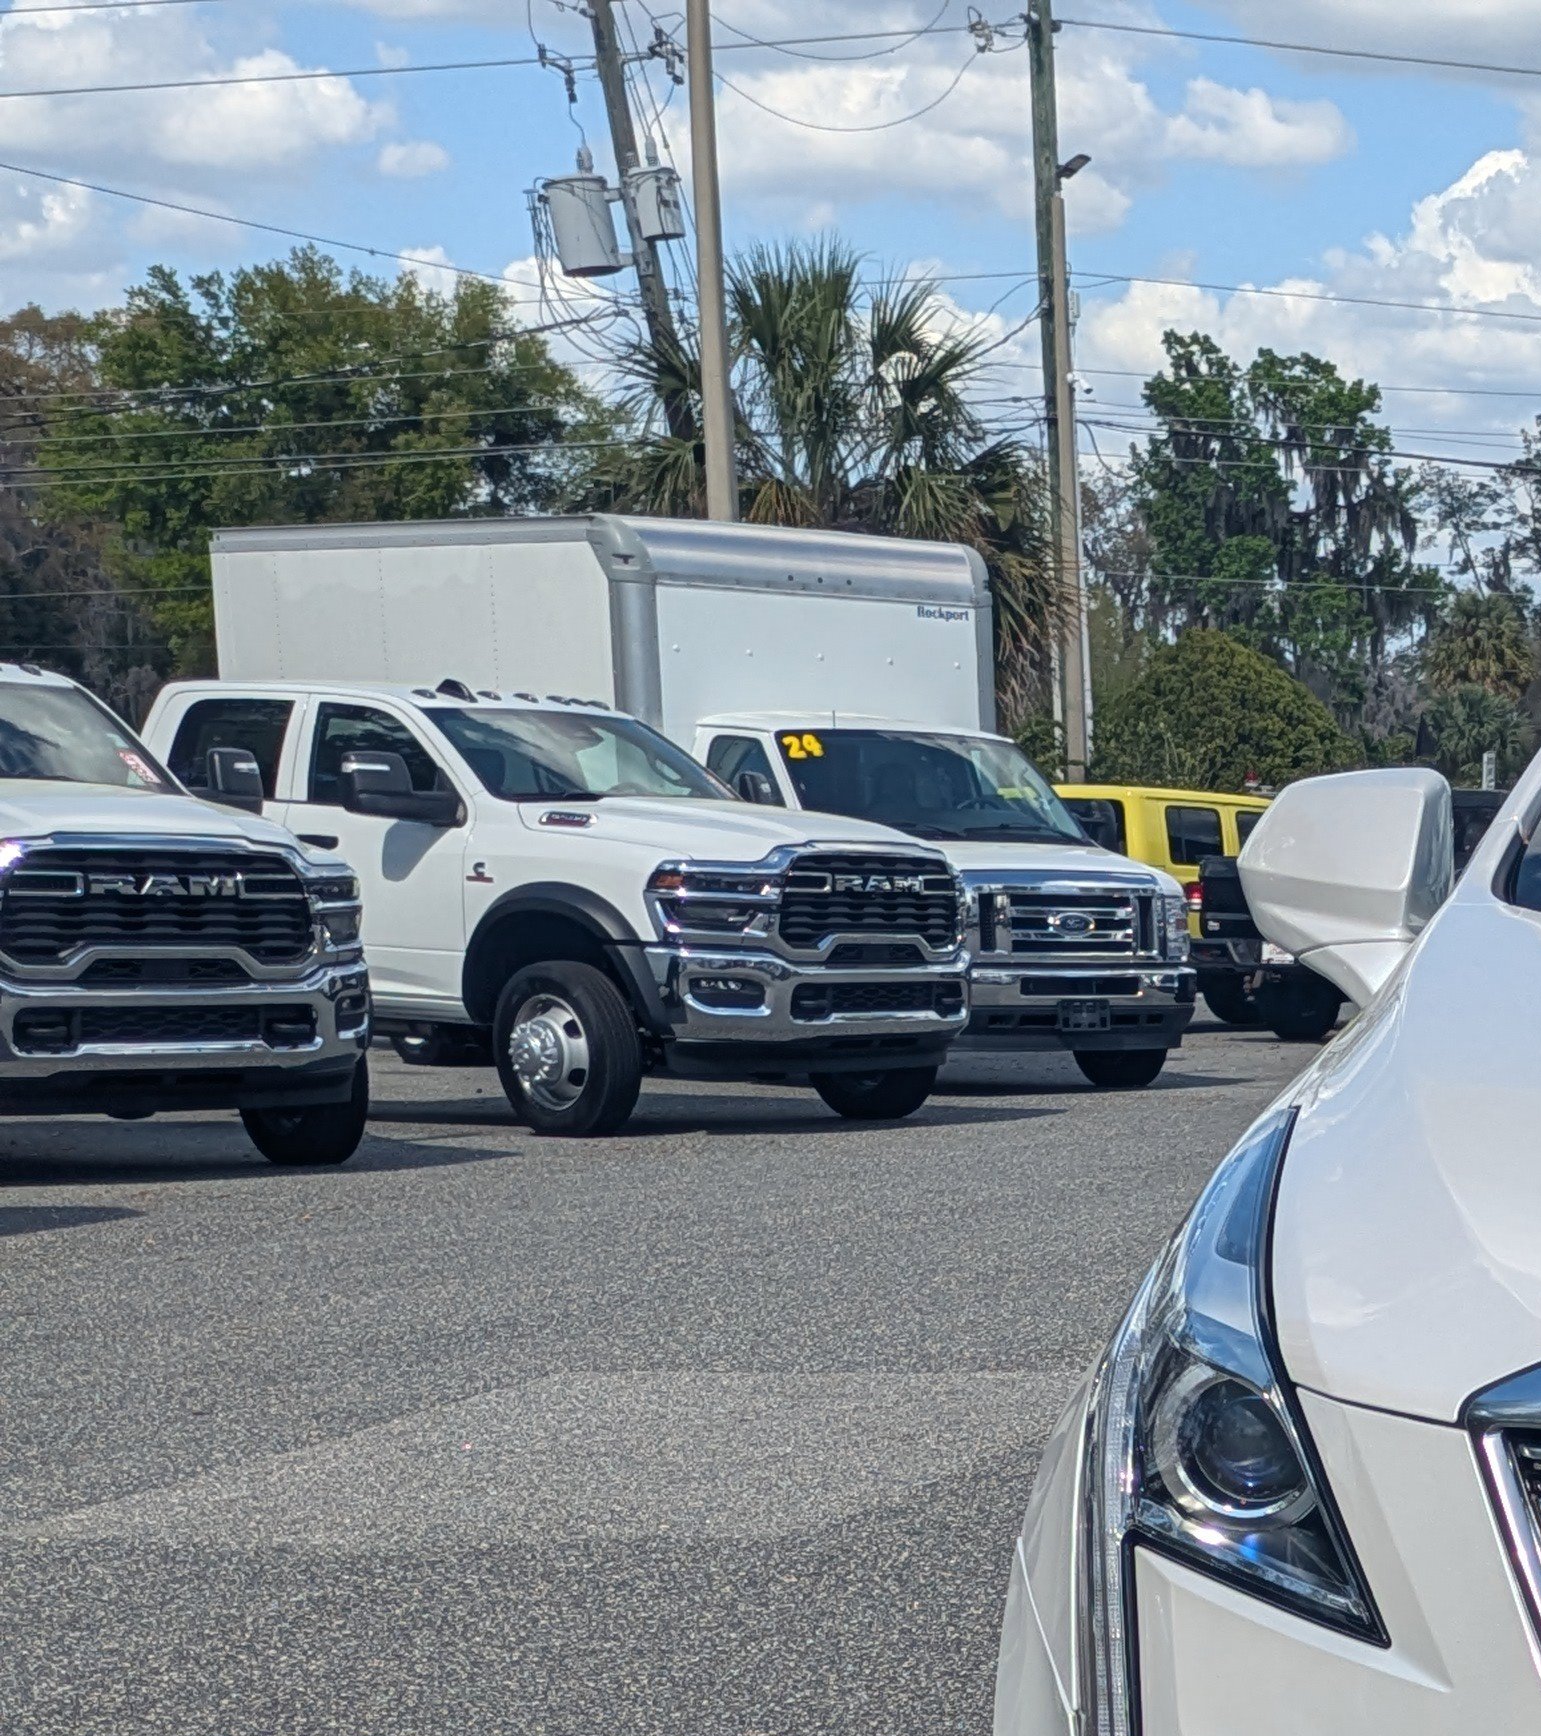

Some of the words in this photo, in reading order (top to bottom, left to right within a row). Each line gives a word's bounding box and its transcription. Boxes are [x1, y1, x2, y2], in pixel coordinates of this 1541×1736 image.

[916, 605, 970, 622] Rockport
[781, 733, 825, 759] 24
[88, 872, 236, 896] RAM
[833, 874, 921, 893] RAM
